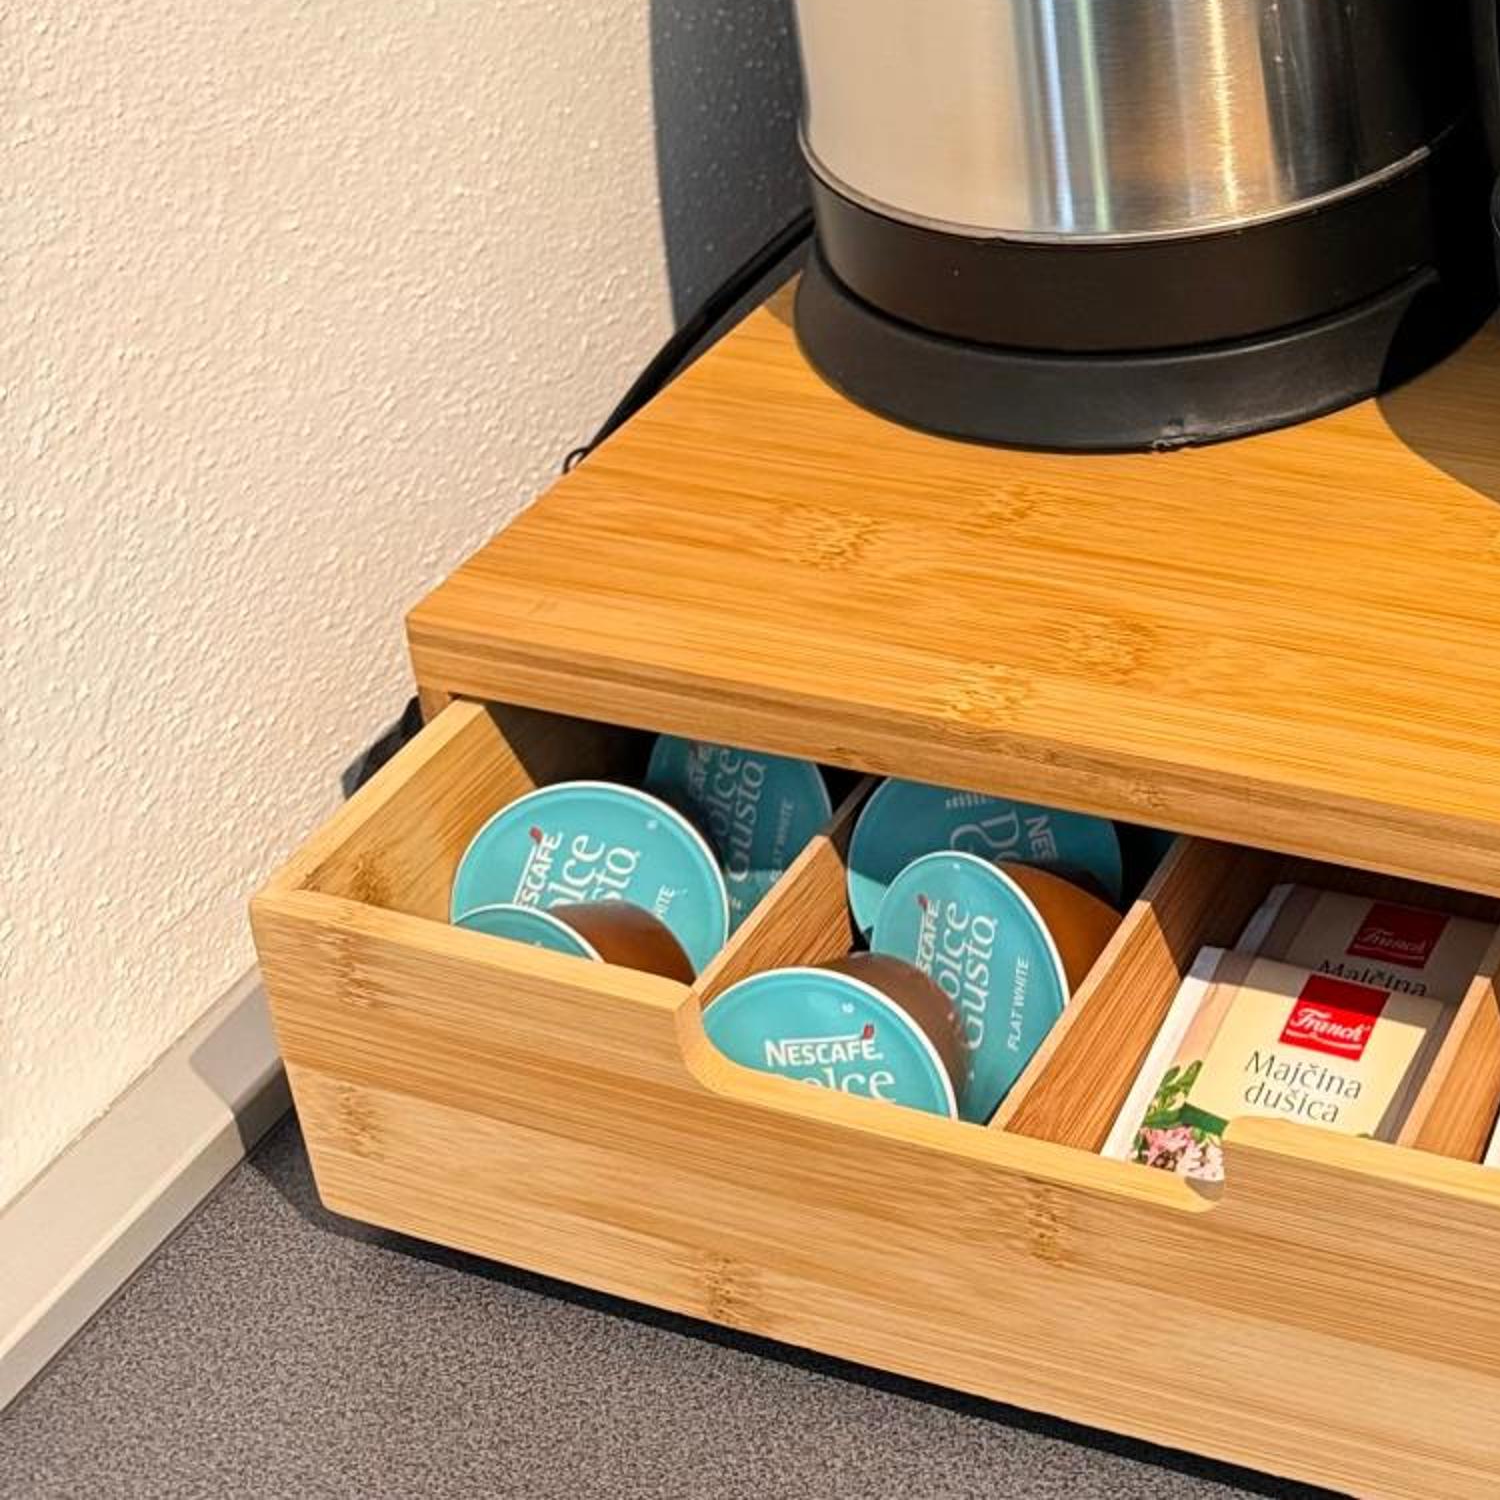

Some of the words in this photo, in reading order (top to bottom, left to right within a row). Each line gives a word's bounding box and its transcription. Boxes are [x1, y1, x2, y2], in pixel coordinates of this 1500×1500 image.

[708, 749, 741, 836] olce
[937, 902, 970, 1000] olce
[960, 915, 998, 1050] Gusto
[1013, 956, 1029, 1006] WHITE
[1008, 1010, 1023, 1050] FLAT
[1290, 1008, 1364, 1042] Franck
[1243, 1050, 1363, 1101] Majčina
[1243, 1079, 1340, 1124] dušica
